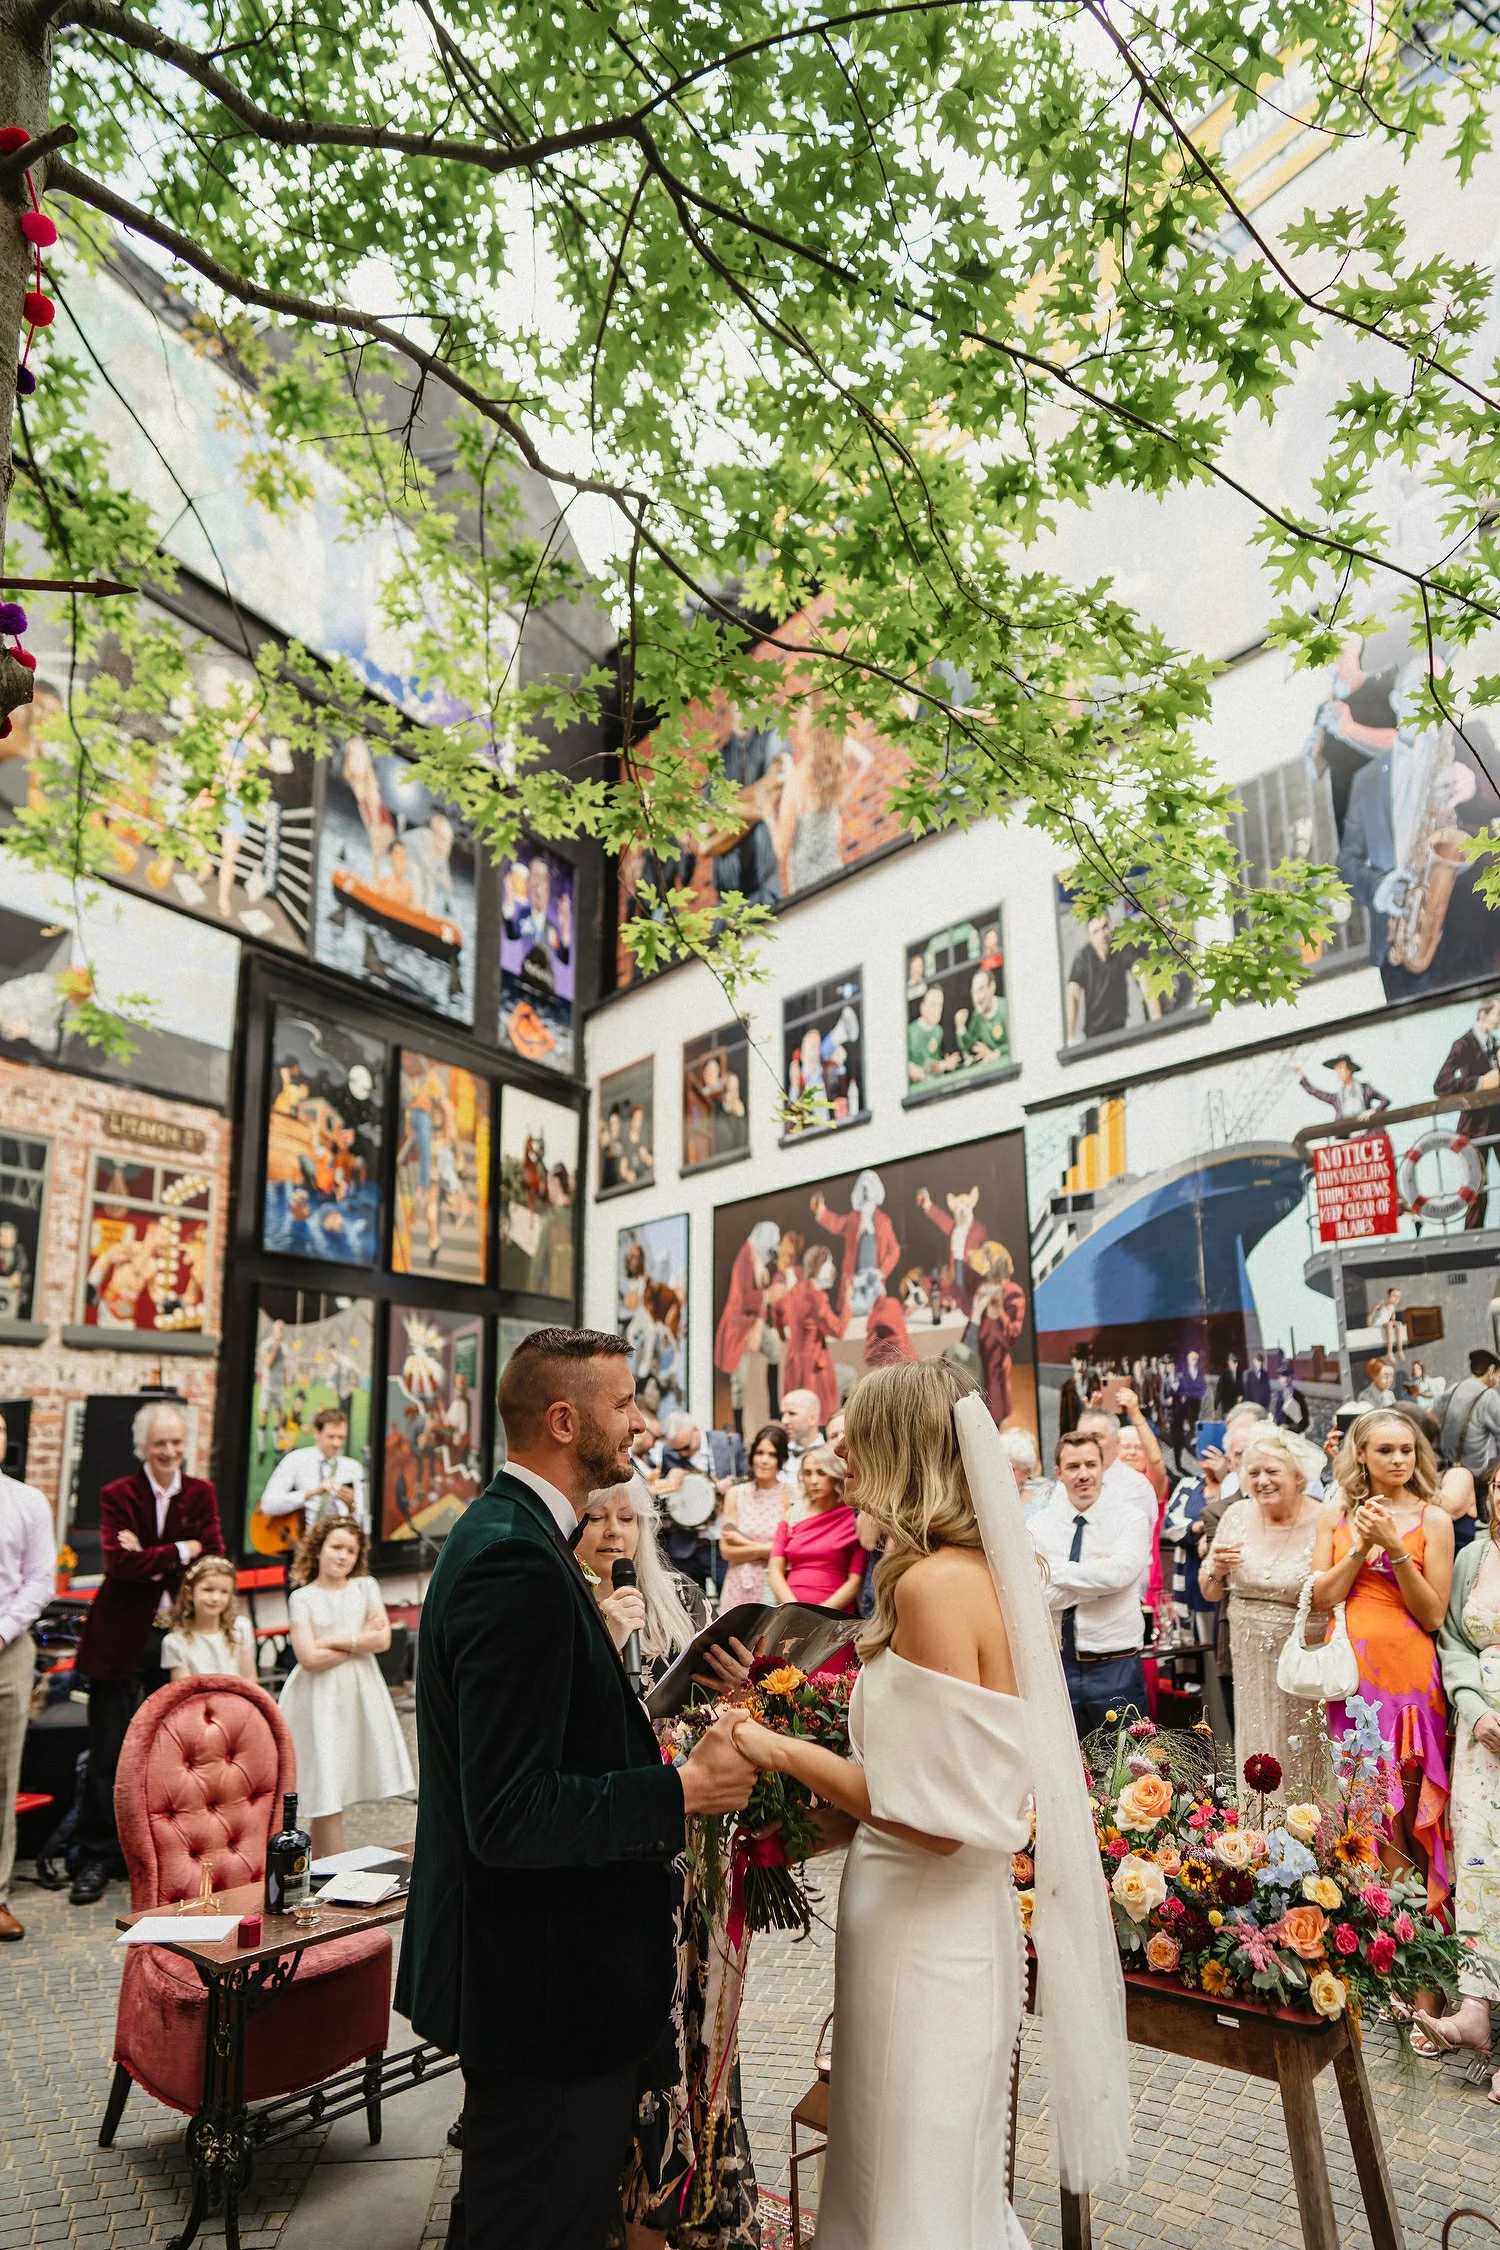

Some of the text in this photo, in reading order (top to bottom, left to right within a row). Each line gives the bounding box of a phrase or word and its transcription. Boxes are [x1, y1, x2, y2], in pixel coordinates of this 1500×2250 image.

[1317, 1139, 1386, 1170] NOTICE
[1316, 1169, 1340, 1188] THIS
[1368, 1161, 1390, 1180] HAS
[1317, 1184, 1351, 1206] TRIPLE
[1352, 1179, 1390, 1202] SCREWS
[1319, 1197, 1390, 1224] KEEP CLEAR OF
[1335, 1217, 1375, 1239] BLADES
